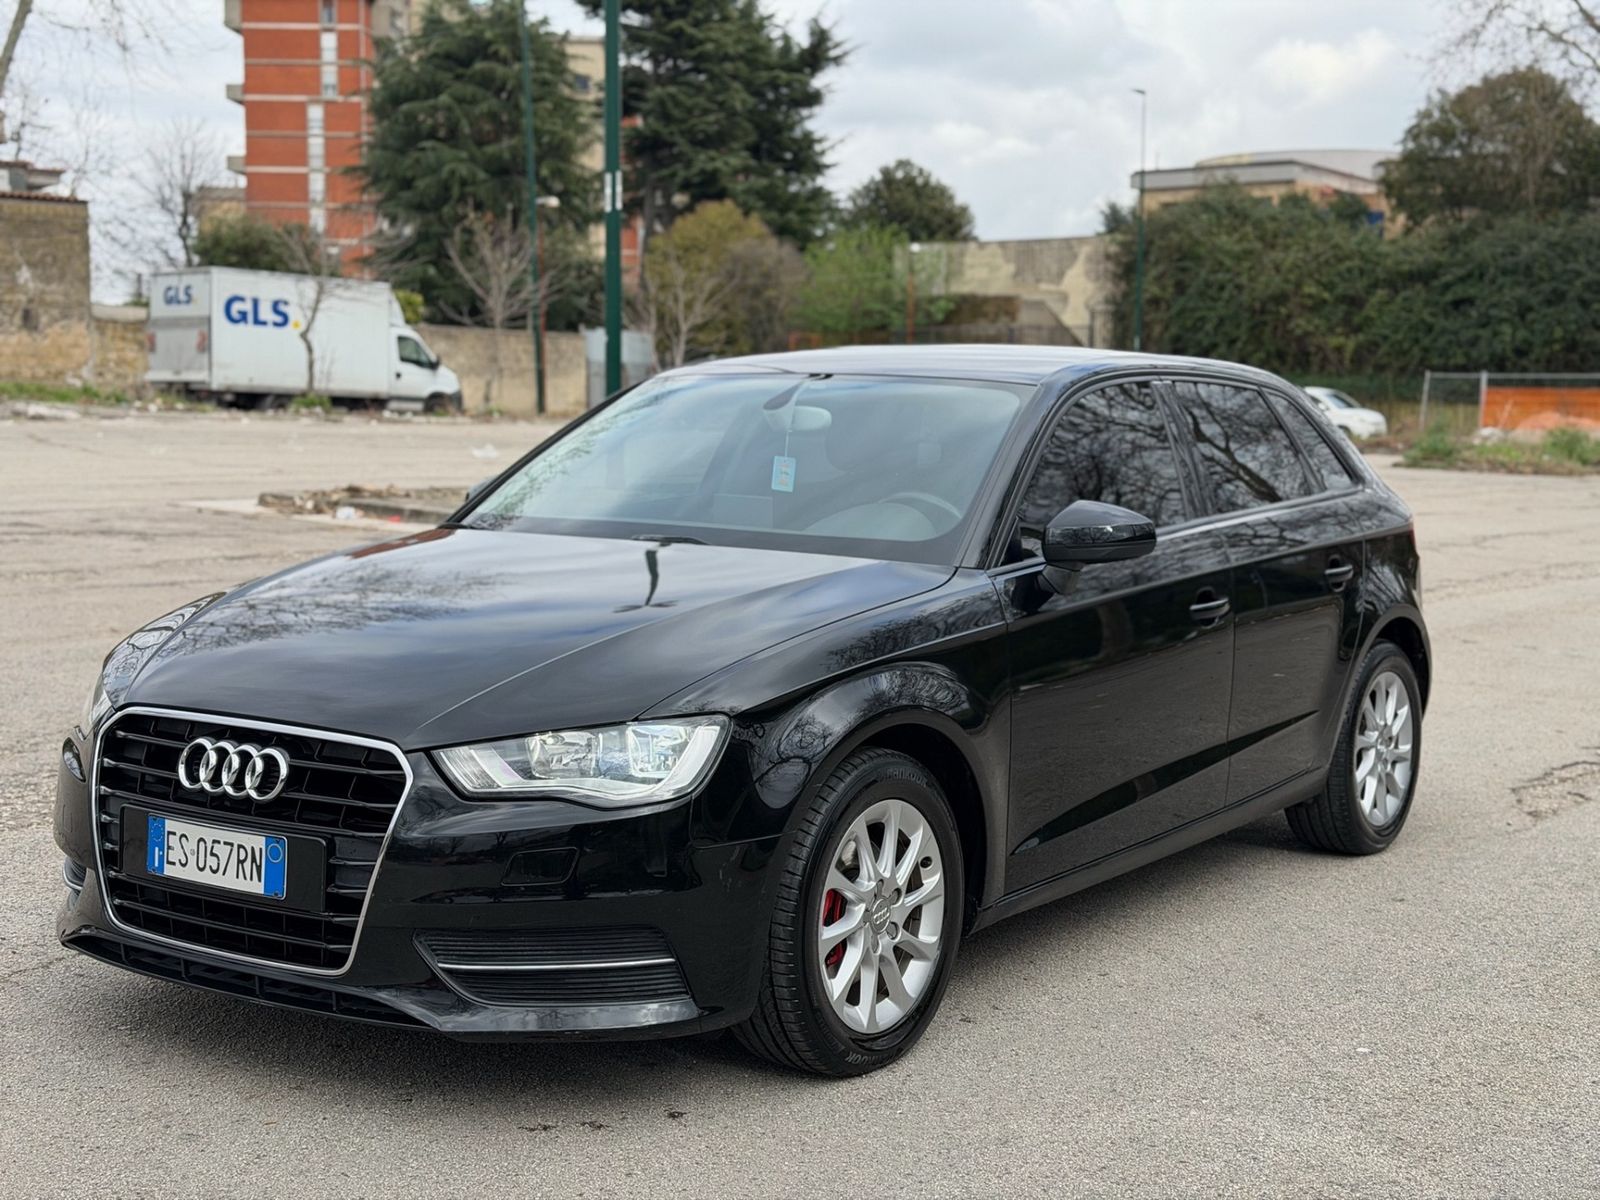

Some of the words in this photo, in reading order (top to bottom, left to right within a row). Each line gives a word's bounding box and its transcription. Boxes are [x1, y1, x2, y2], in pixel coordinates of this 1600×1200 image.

[164, 286, 192, 304] GLS
[166, 831, 190, 868] ES
[196, 837, 263, 883] 057RN
